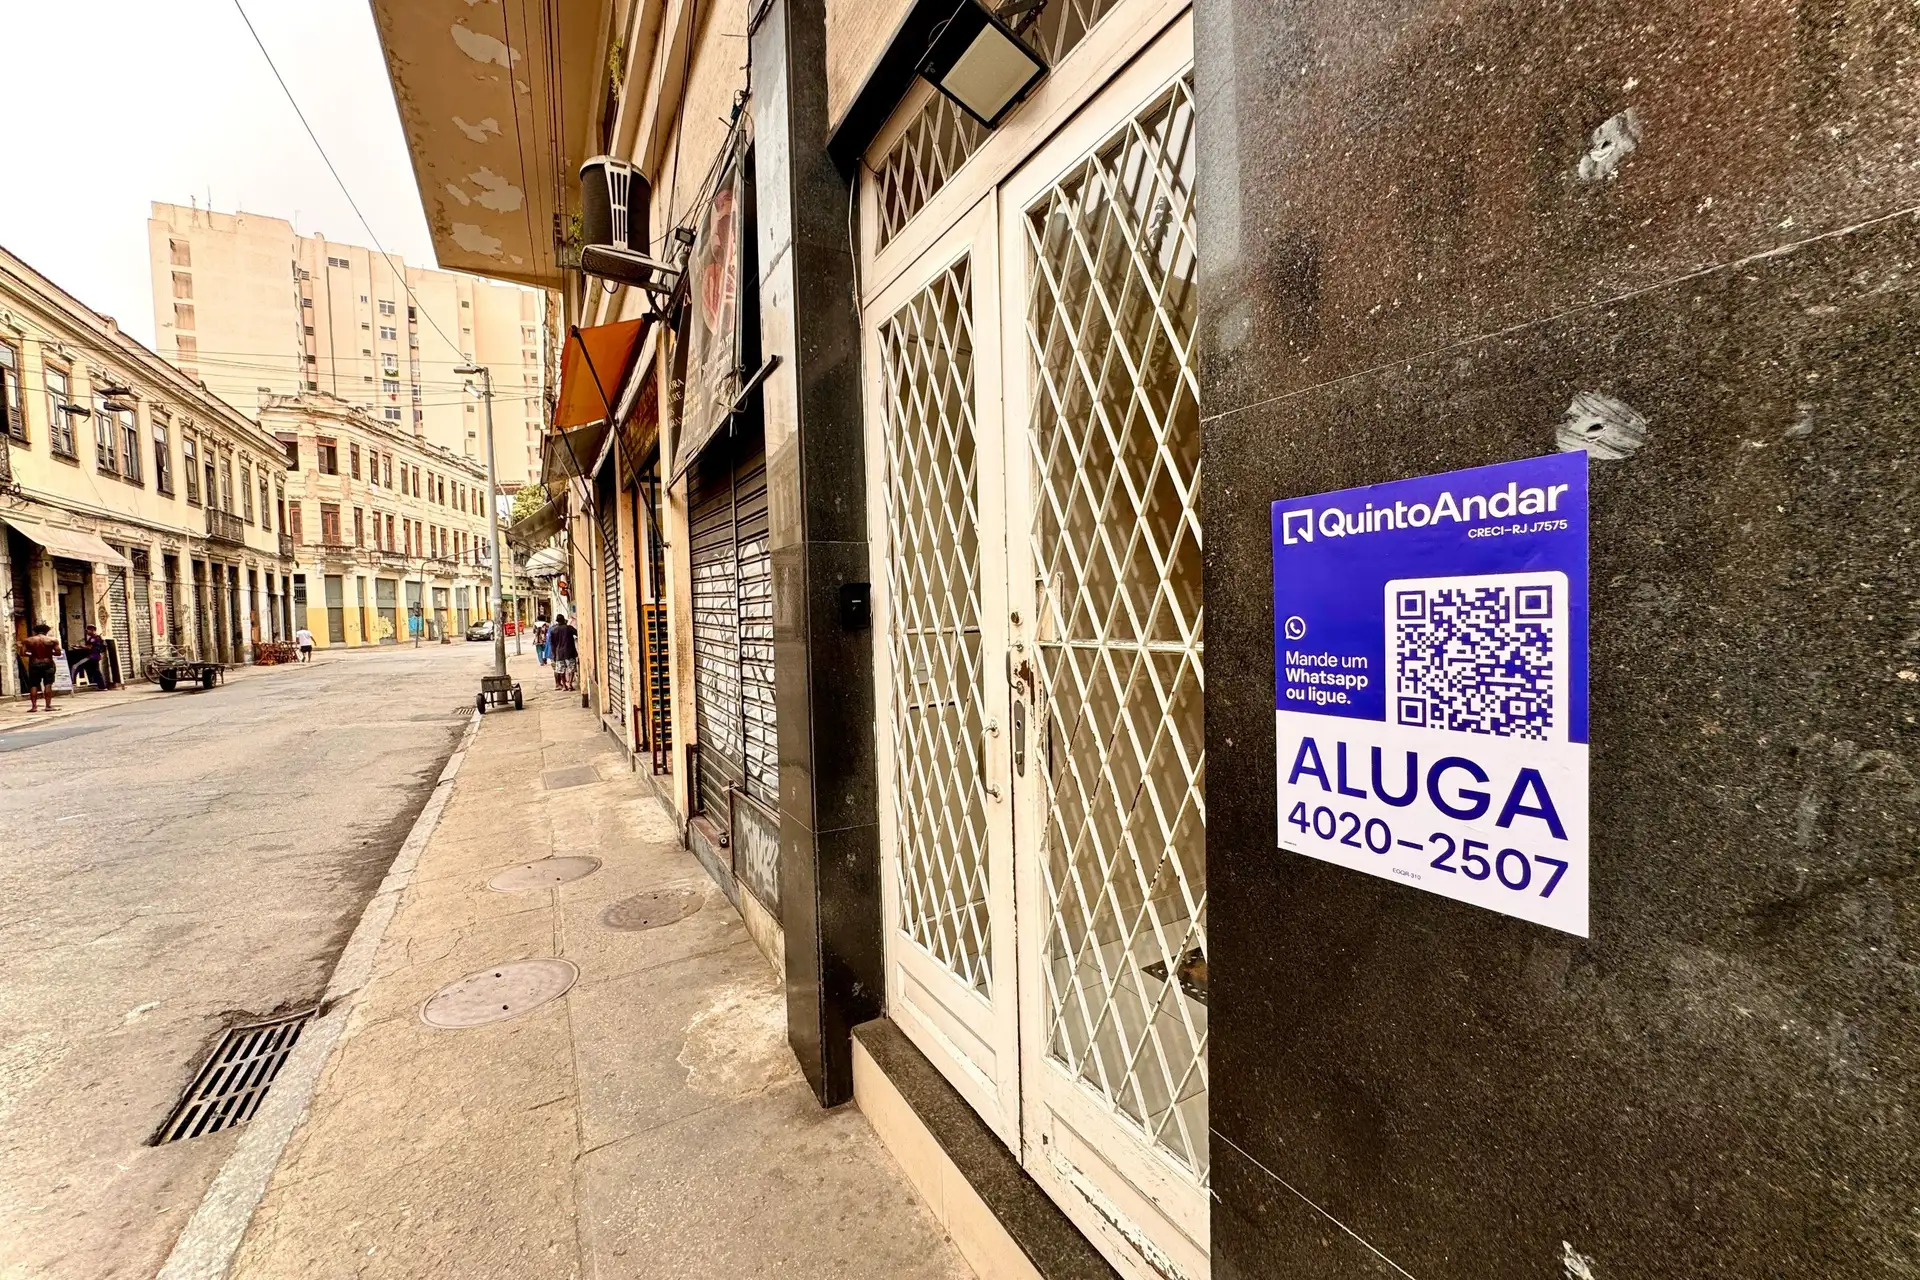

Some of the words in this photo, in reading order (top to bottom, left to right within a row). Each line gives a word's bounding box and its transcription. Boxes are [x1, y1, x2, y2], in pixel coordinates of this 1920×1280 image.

[1318, 482, 1568, 538] QuintoAndar
[1529, 519, 1568, 533] J7575
[1285, 650, 1338, 668] Mande
[1341, 655, 1368, 669] um
[1285, 669, 1369, 690] Whatsapp
[1285, 689, 1305, 700] ou
[1307, 686, 1351, 705] ligue.
[1287, 736, 1569, 841] ALUGA
[1287, 801, 1569, 898] 4020-2507
